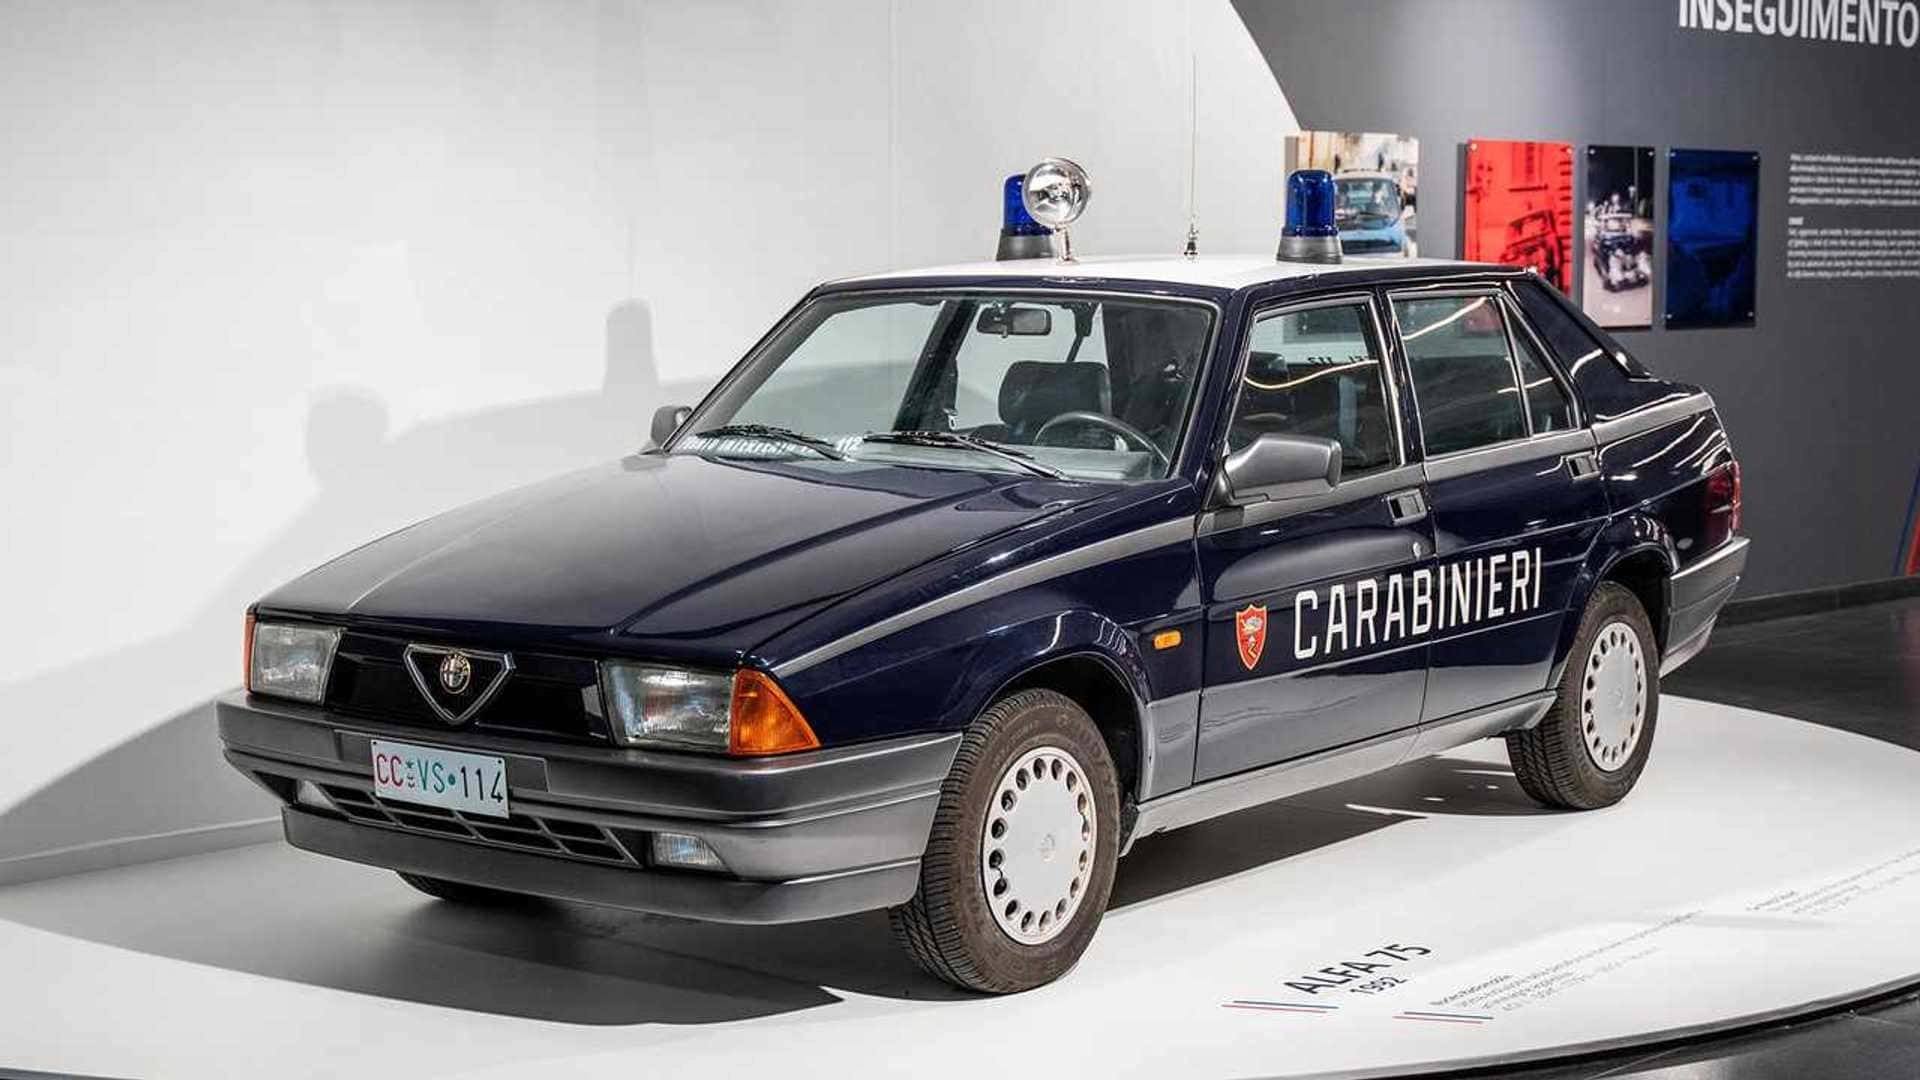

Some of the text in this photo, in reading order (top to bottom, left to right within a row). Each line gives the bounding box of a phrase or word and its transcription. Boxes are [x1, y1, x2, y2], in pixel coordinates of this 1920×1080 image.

[1679, 0, 1919, 47] INSEGUIMENTO
[1294, 547, 1541, 660] CARABINIERI
[376, 753, 404, 787] CC
[460, 765, 504, 803] 114
[1283, 943, 1432, 994] ALFA 75
[1350, 976, 1408, 995] 1992
